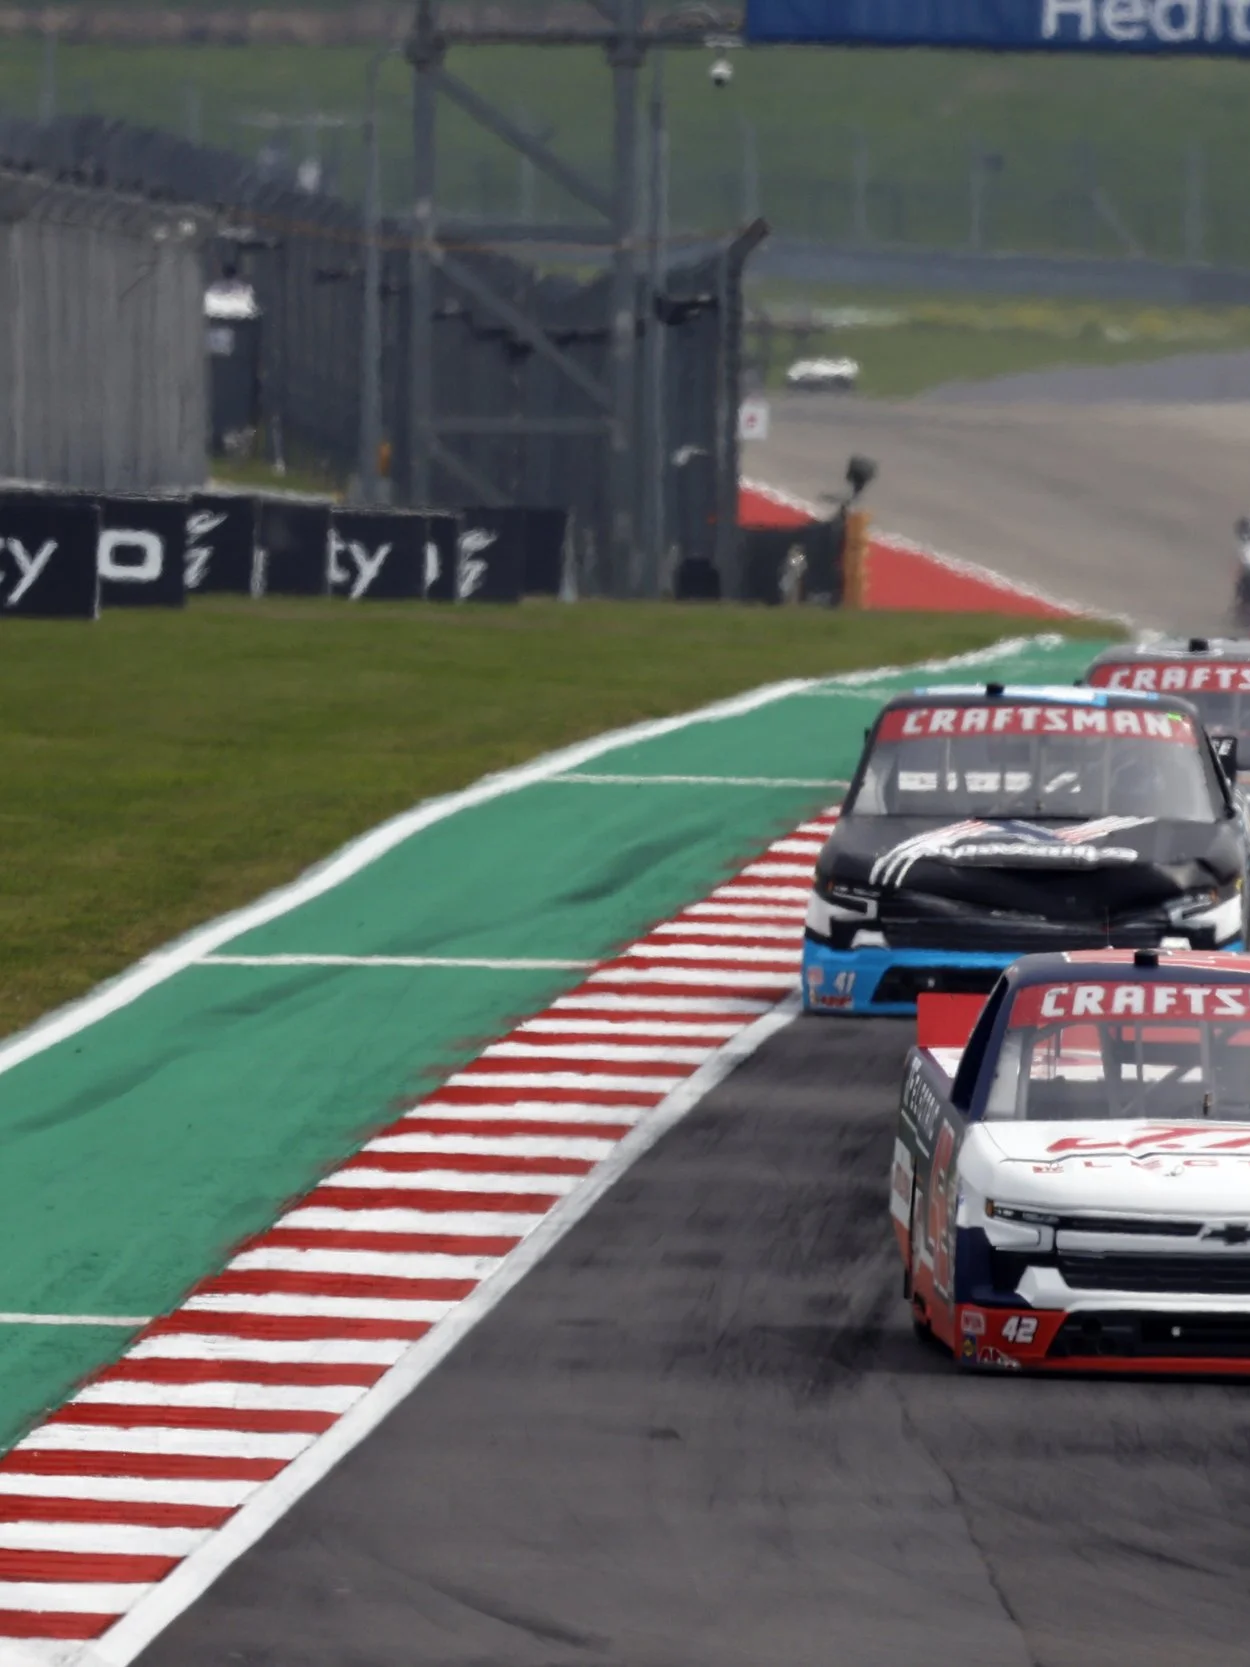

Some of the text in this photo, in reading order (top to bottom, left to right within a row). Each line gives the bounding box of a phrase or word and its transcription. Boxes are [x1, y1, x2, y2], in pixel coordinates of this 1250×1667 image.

[0, 536, 58, 605] y
[902, 706, 1173, 738] CRAFTSMAN
[1001, 1315, 1038, 1344] 42
